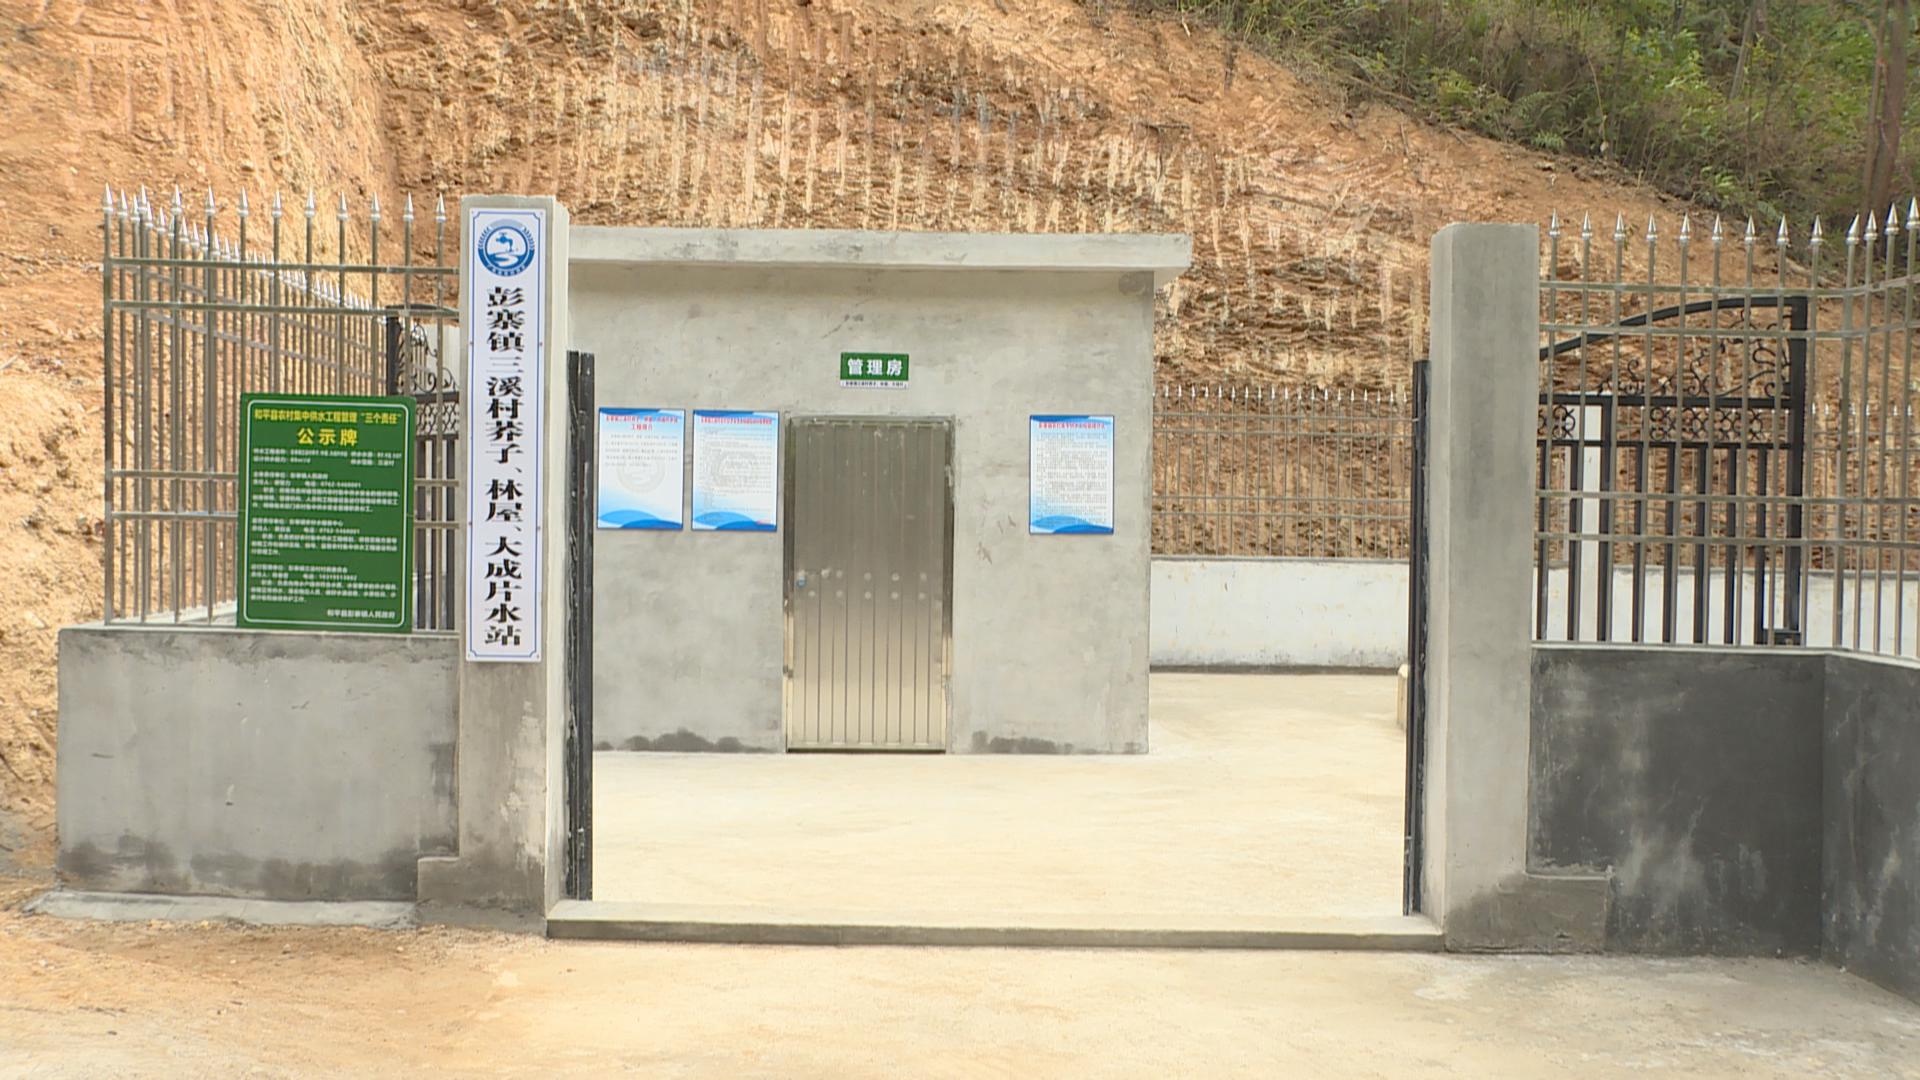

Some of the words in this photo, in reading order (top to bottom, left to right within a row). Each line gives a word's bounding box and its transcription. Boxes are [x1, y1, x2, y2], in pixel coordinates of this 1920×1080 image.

[847, 357, 903, 376] 管理房
[297, 427, 358, 446] 公示牌
